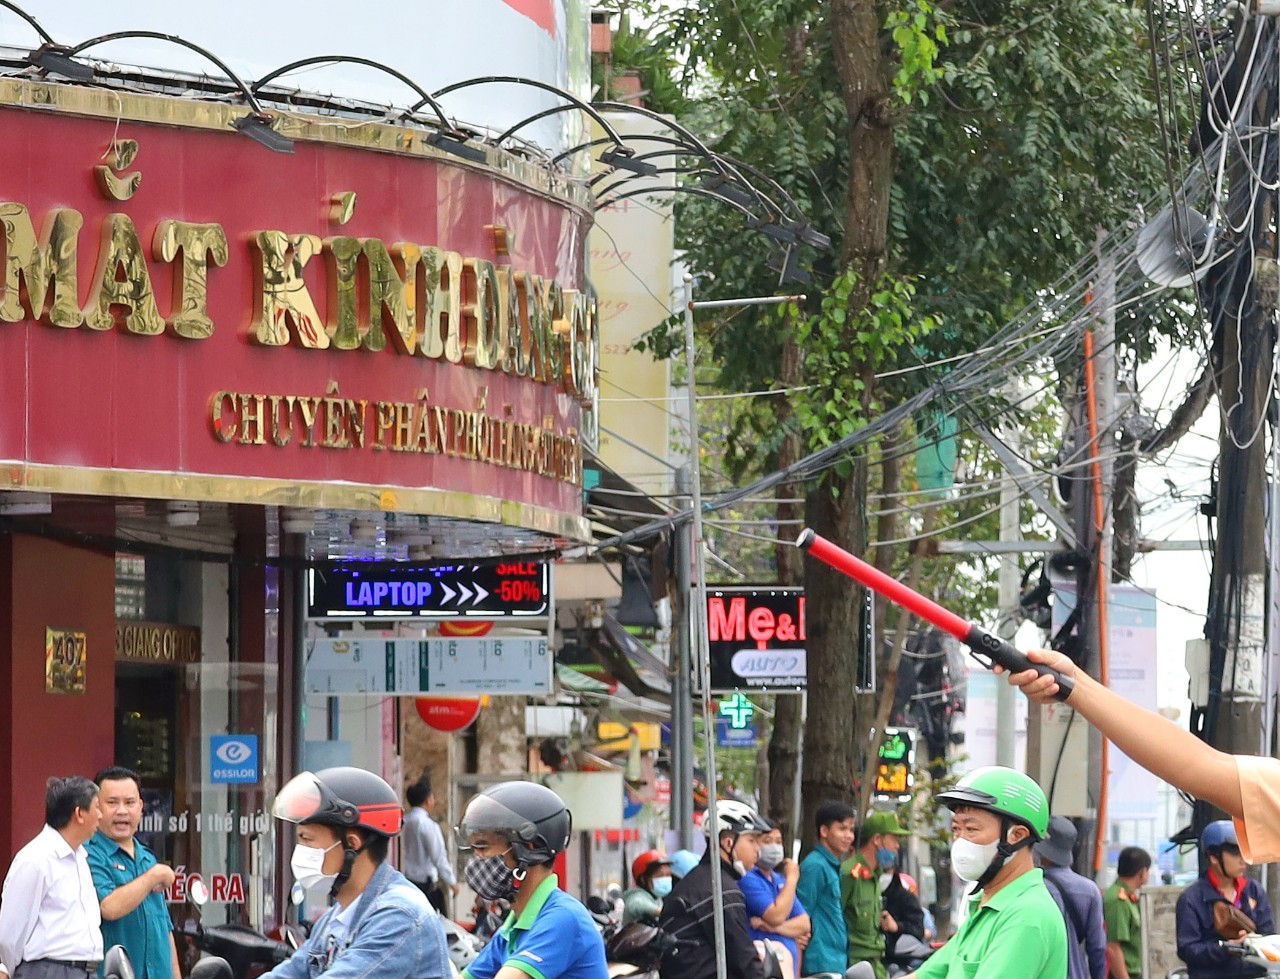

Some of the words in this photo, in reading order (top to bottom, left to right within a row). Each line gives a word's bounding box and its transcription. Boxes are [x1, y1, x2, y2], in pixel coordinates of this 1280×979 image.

[0, 138, 230, 340] MẮT
[250, 191, 464, 364] KÍNH
[210, 379, 368, 447] CHUYÊN
[371, 387, 450, 455] PHÂN
[346, 581, 432, 607] LAPTOP
[494, 580, 540, 603] -50%
[51, 634, 84, 666] 407
[124, 625, 160, 660] GIANG
[195, 812, 202, 832] 1
[211, 873, 246, 903] RA
